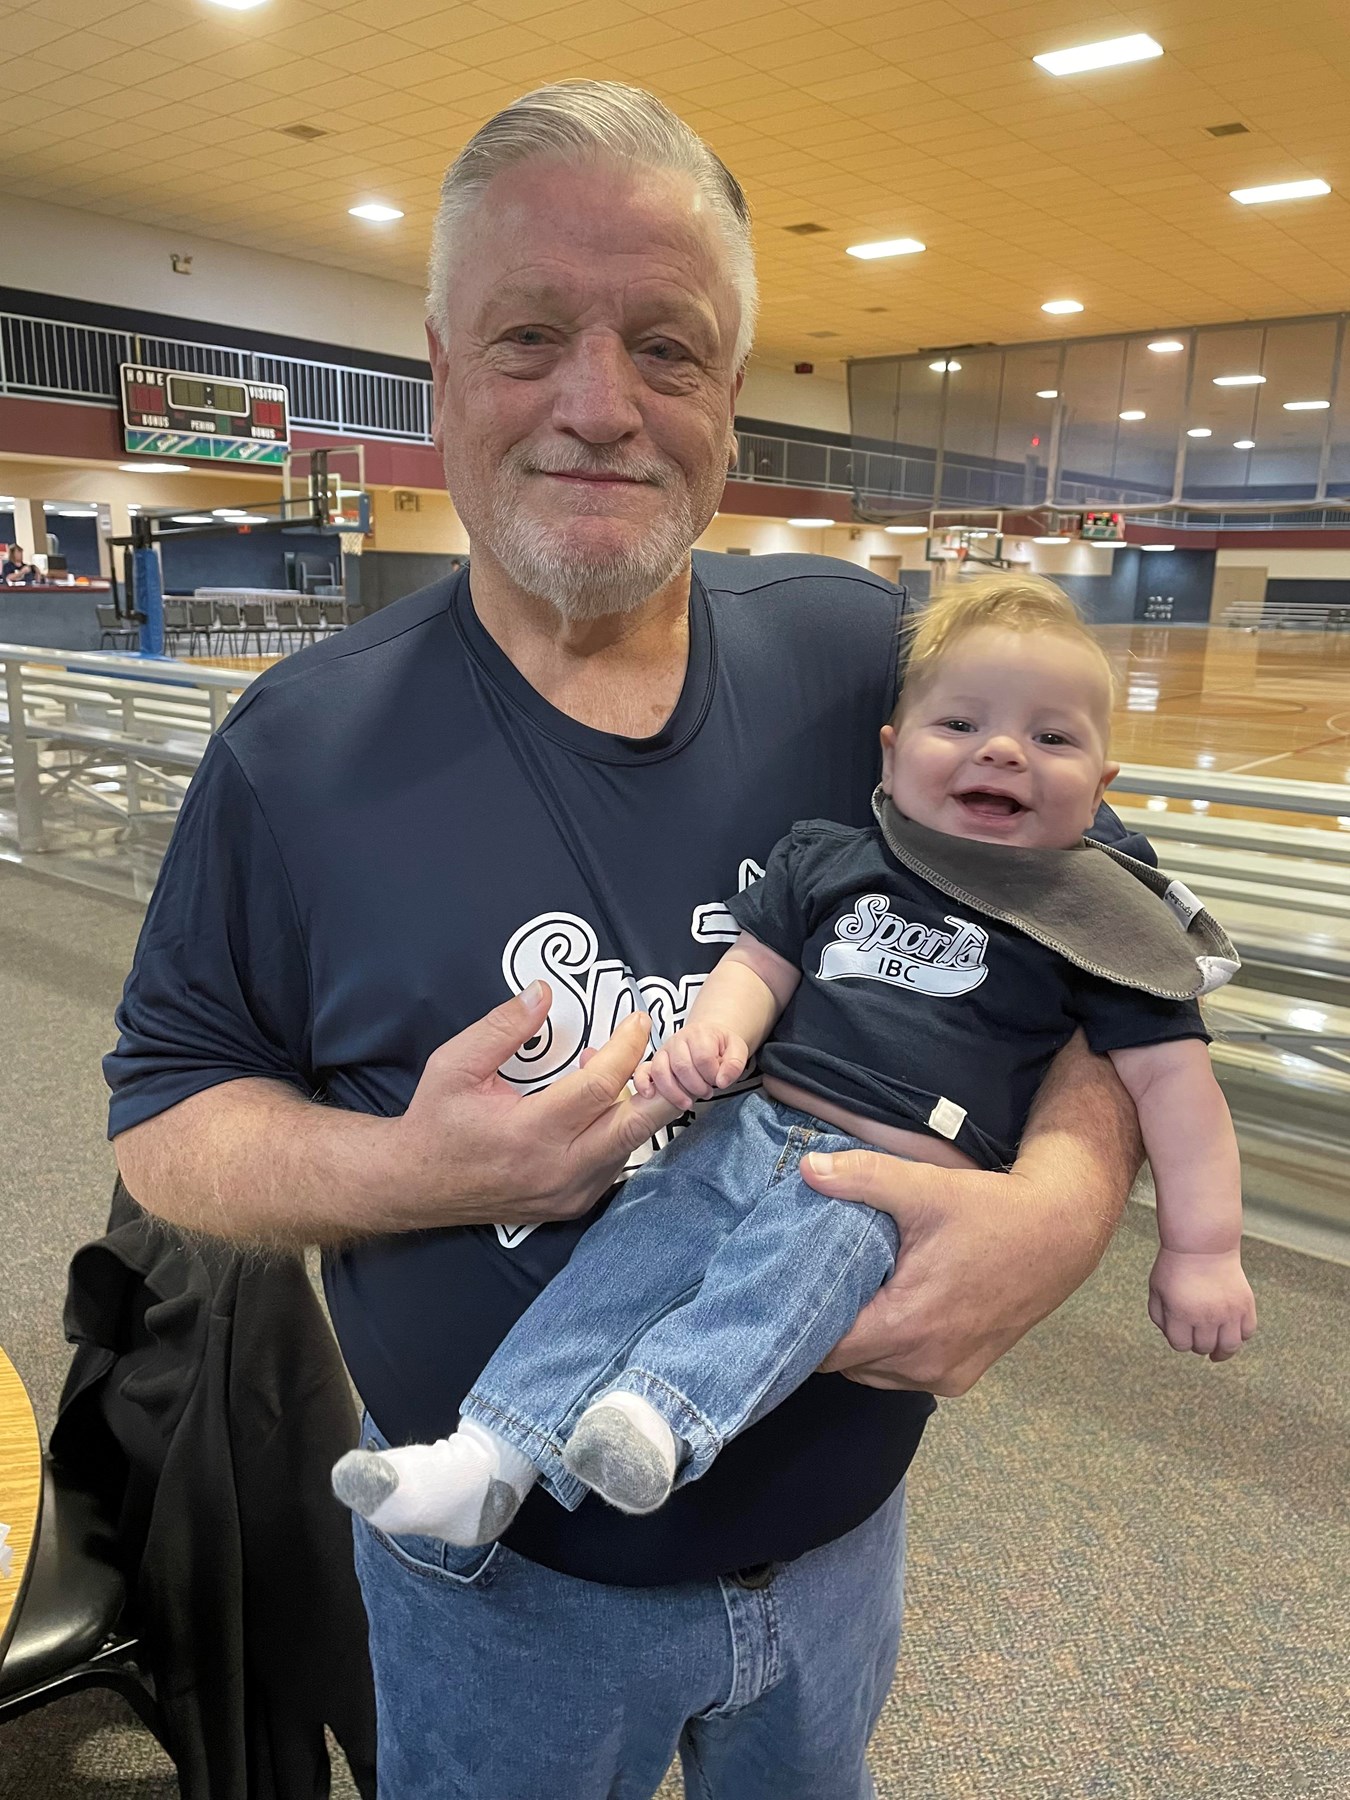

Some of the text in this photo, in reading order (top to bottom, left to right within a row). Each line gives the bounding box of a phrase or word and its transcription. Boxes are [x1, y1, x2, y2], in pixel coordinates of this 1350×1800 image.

[126, 369, 165, 387] HOME
[249, 386, 285, 403] VISITOR
[141, 414, 170, 428] BONUS
[190, 419, 216, 433] PERIOD
[250, 426, 277, 440] BONUS
[877, 957, 920, 983] IBC
